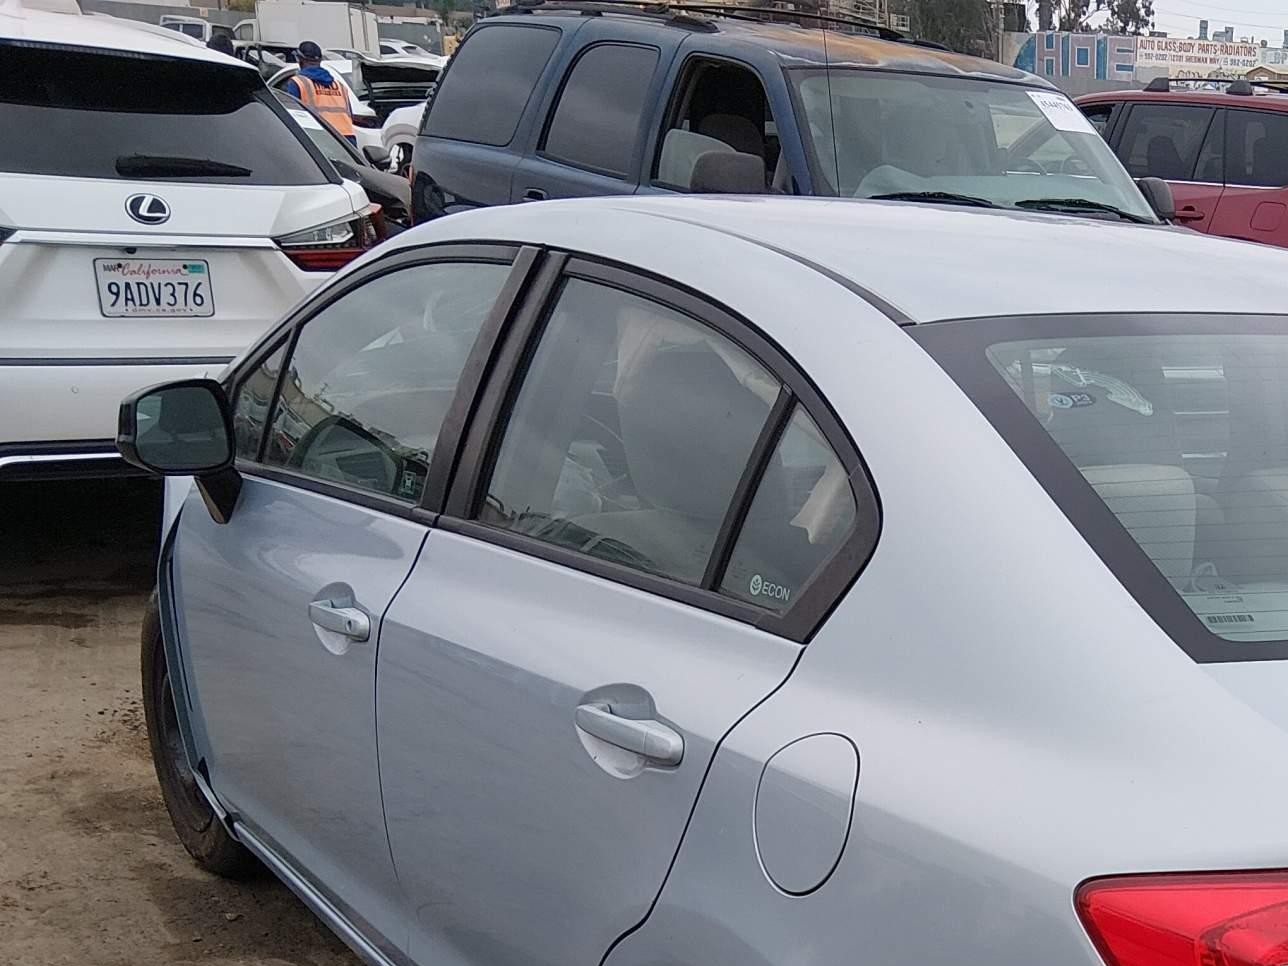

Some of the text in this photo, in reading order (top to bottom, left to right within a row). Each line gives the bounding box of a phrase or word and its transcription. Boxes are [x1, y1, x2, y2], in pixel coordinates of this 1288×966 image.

[1139, 39, 1155, 51] AUTO
[1156, 40, 1177, 52] GLASS
[1197, 42, 1217, 55] PARTS
[1219, 43, 1258, 58] RADIATORS
[121, 263, 190, 280] California
[107, 281, 205, 307] 9ADV376
[761, 581, 791, 601] ECON
